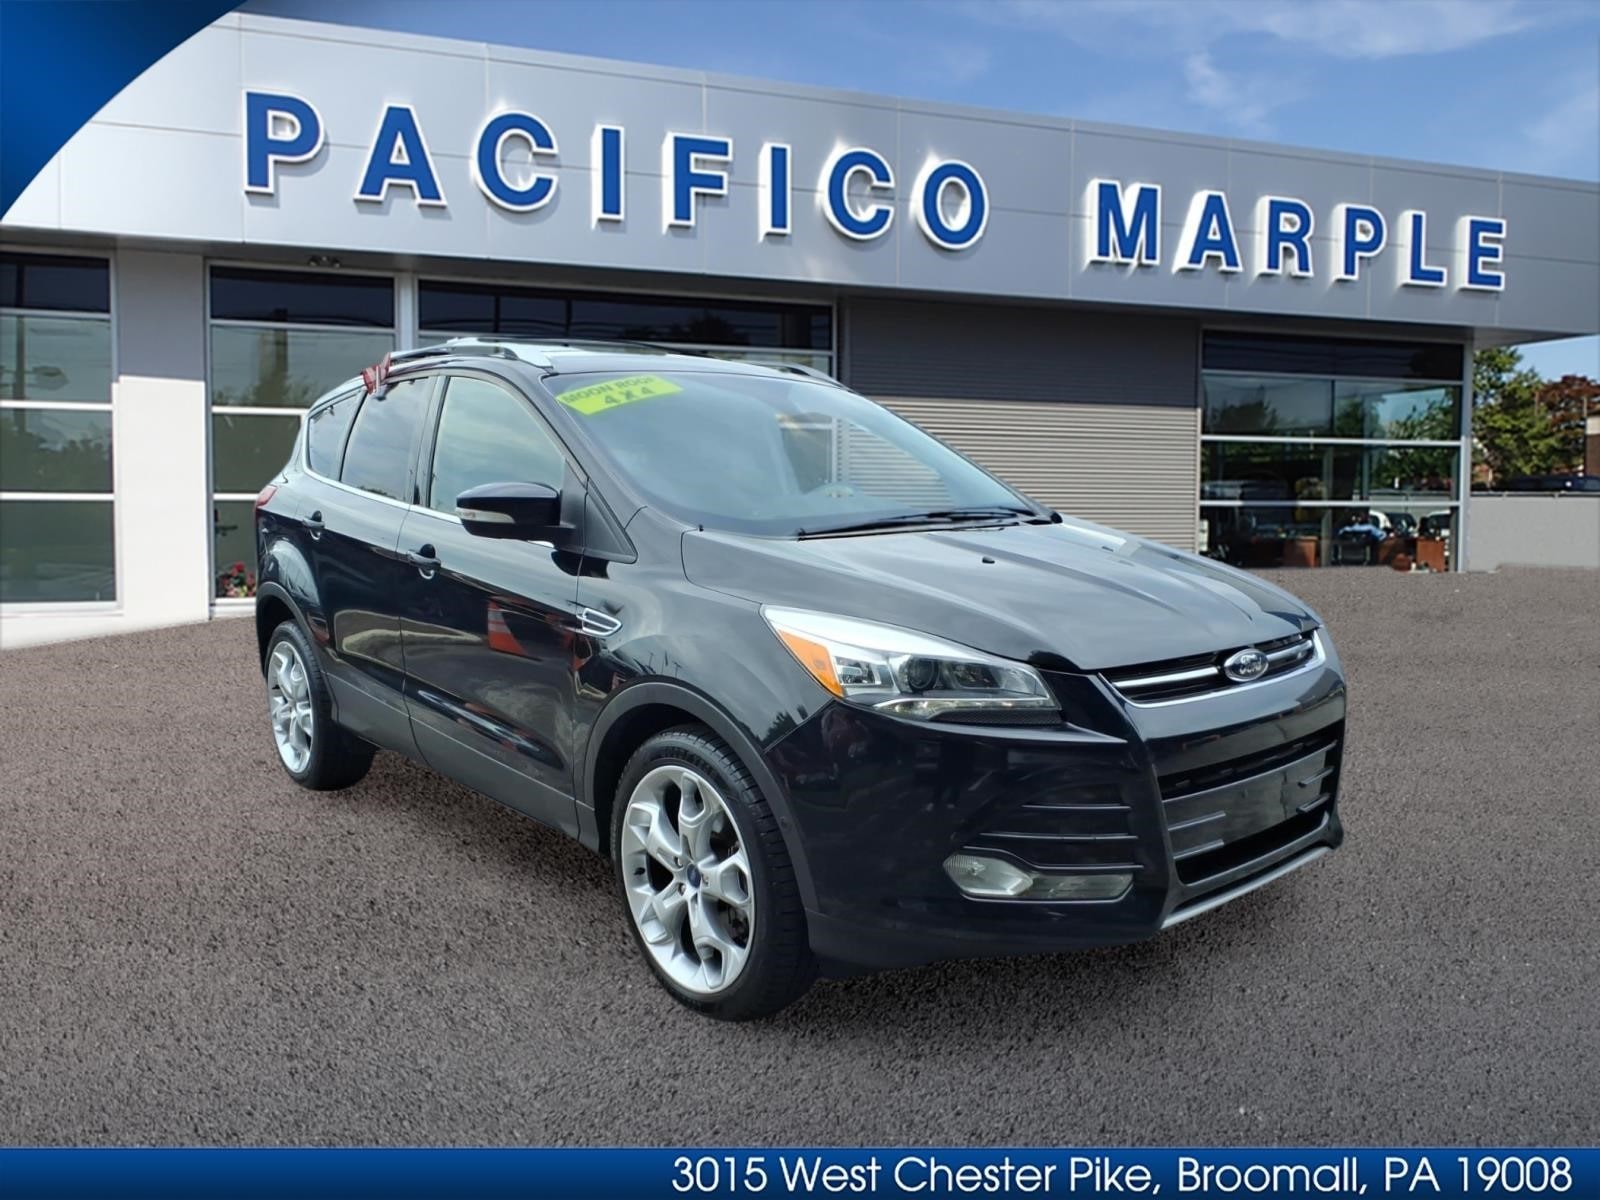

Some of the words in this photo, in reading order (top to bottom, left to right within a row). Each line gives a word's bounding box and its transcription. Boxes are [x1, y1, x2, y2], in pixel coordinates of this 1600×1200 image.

[244, 89, 988, 249] PACIFICO
[1090, 180, 1506, 290] MARPLE
[562, 384, 614, 403] MOON
